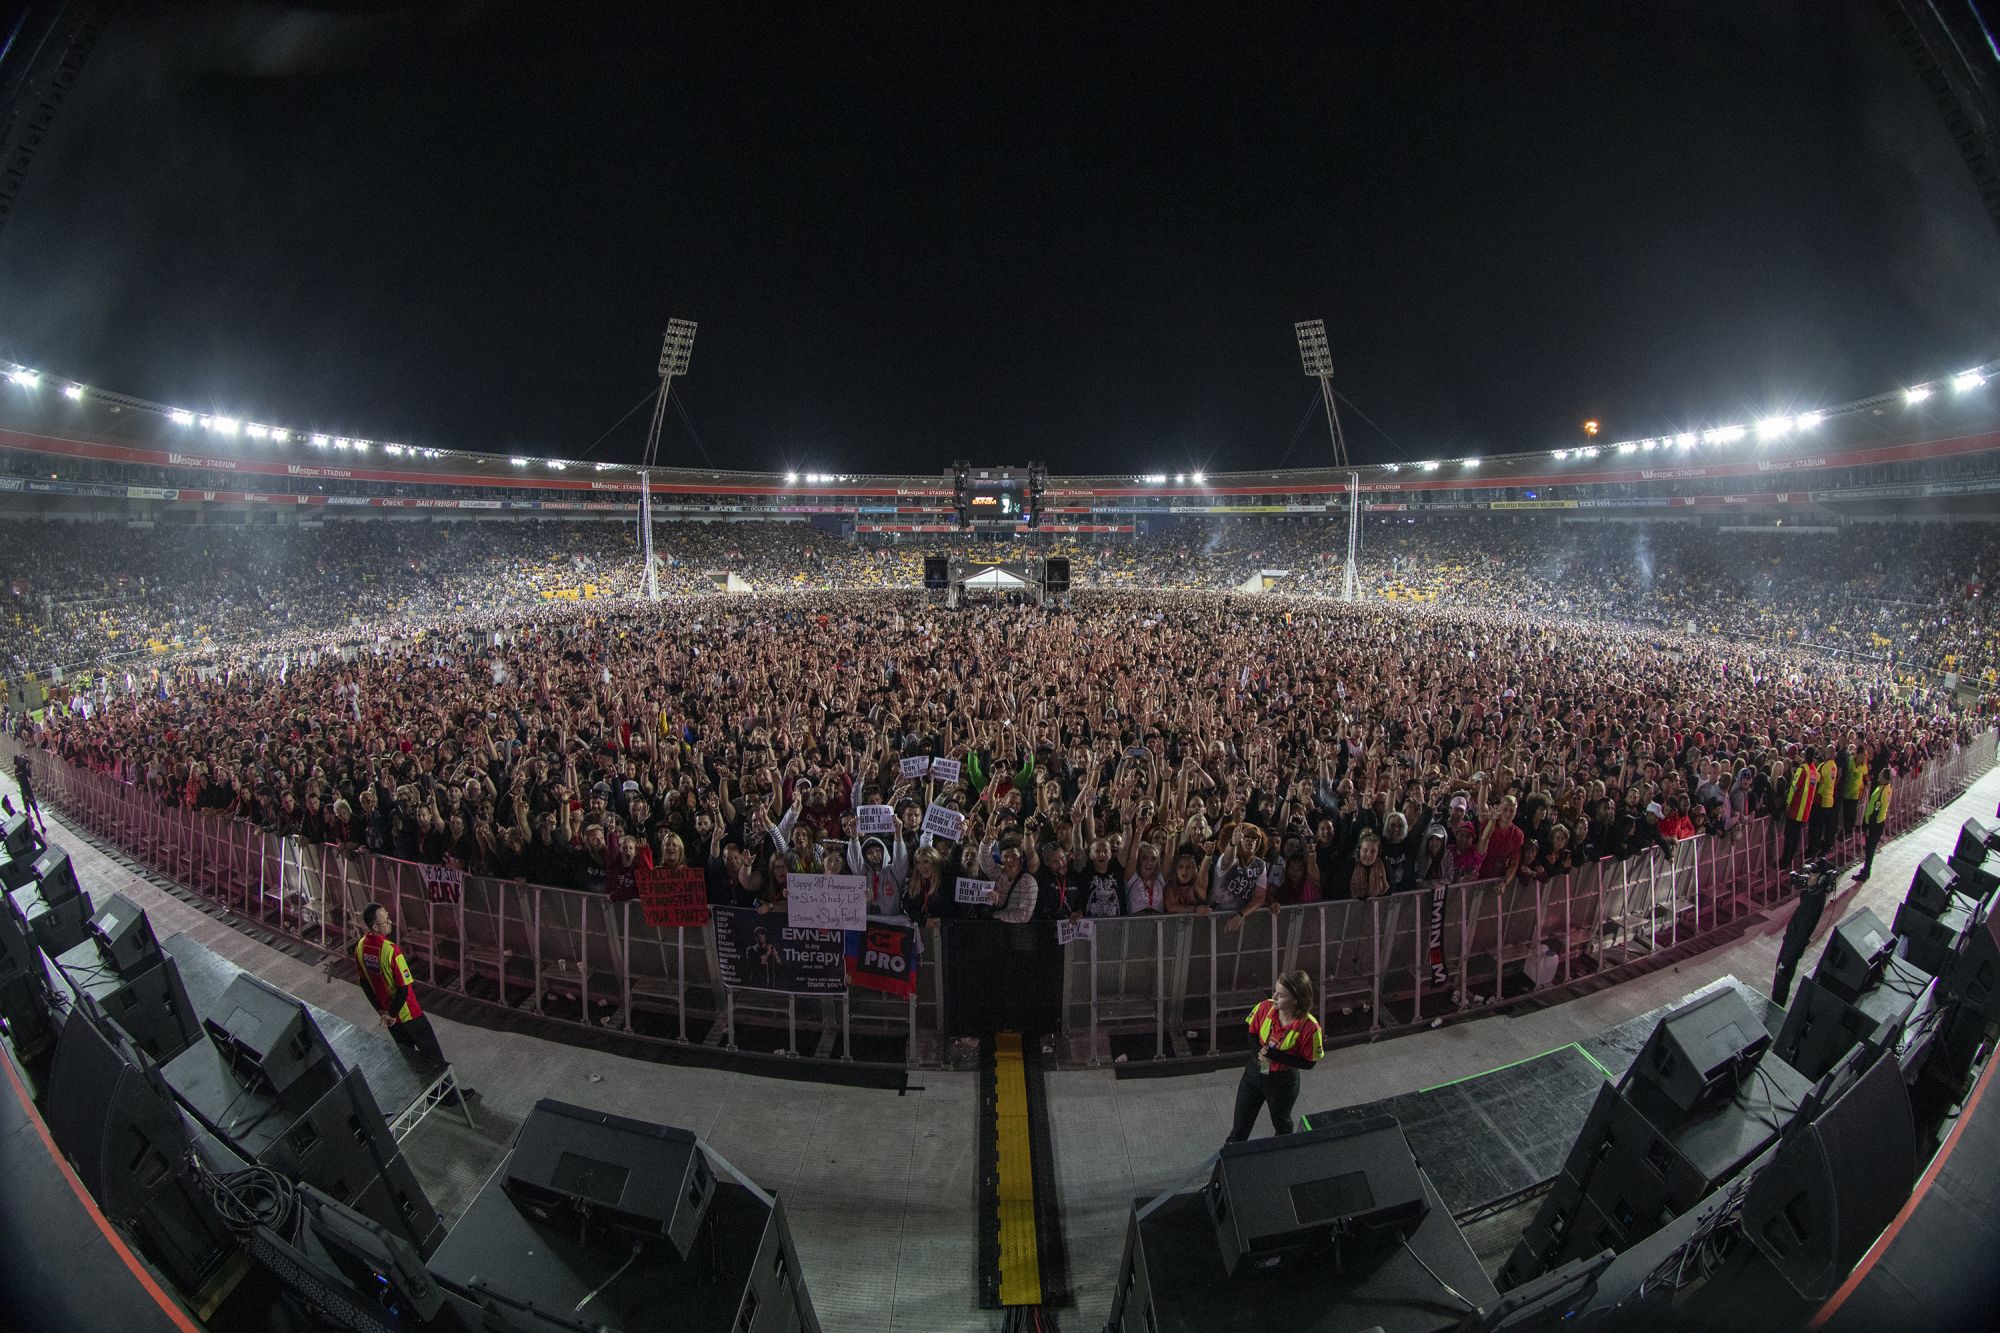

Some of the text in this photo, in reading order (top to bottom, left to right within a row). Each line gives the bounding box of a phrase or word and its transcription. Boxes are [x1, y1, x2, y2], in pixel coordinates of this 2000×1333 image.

[169, 453, 236, 469] Westpac STADIUM
[1758, 458, 1826, 471] Westpac STADIUM
[288, 465, 351, 478] Westpac STADIUM
[1642, 469, 1706, 479] Westpac STADIUM
[592, 482, 620, 490] Westpac
[245, 494, 268, 502] Westpac
[930, 808, 955, 820] LET'S GET
[877, 823, 892, 831] FUCK!
[928, 816, 949, 827] DOWN
[788, 876, 812, 891] Happy
[960, 881, 983, 890] WE ALL
[959, 888, 980, 896] DON'T
[800, 892, 817, 904] Slim
[820, 892, 846, 908] Shady
[847, 892, 862, 904] LP
[675, 909, 708, 923] PANTS
[782, 928, 841, 943] EMINEM
[1430, 886, 1447, 984] EMINEM
[719, 952, 742, 960] Recovery
[783, 948, 840, 966] Therapy
[864, 950, 906, 973] PRO
